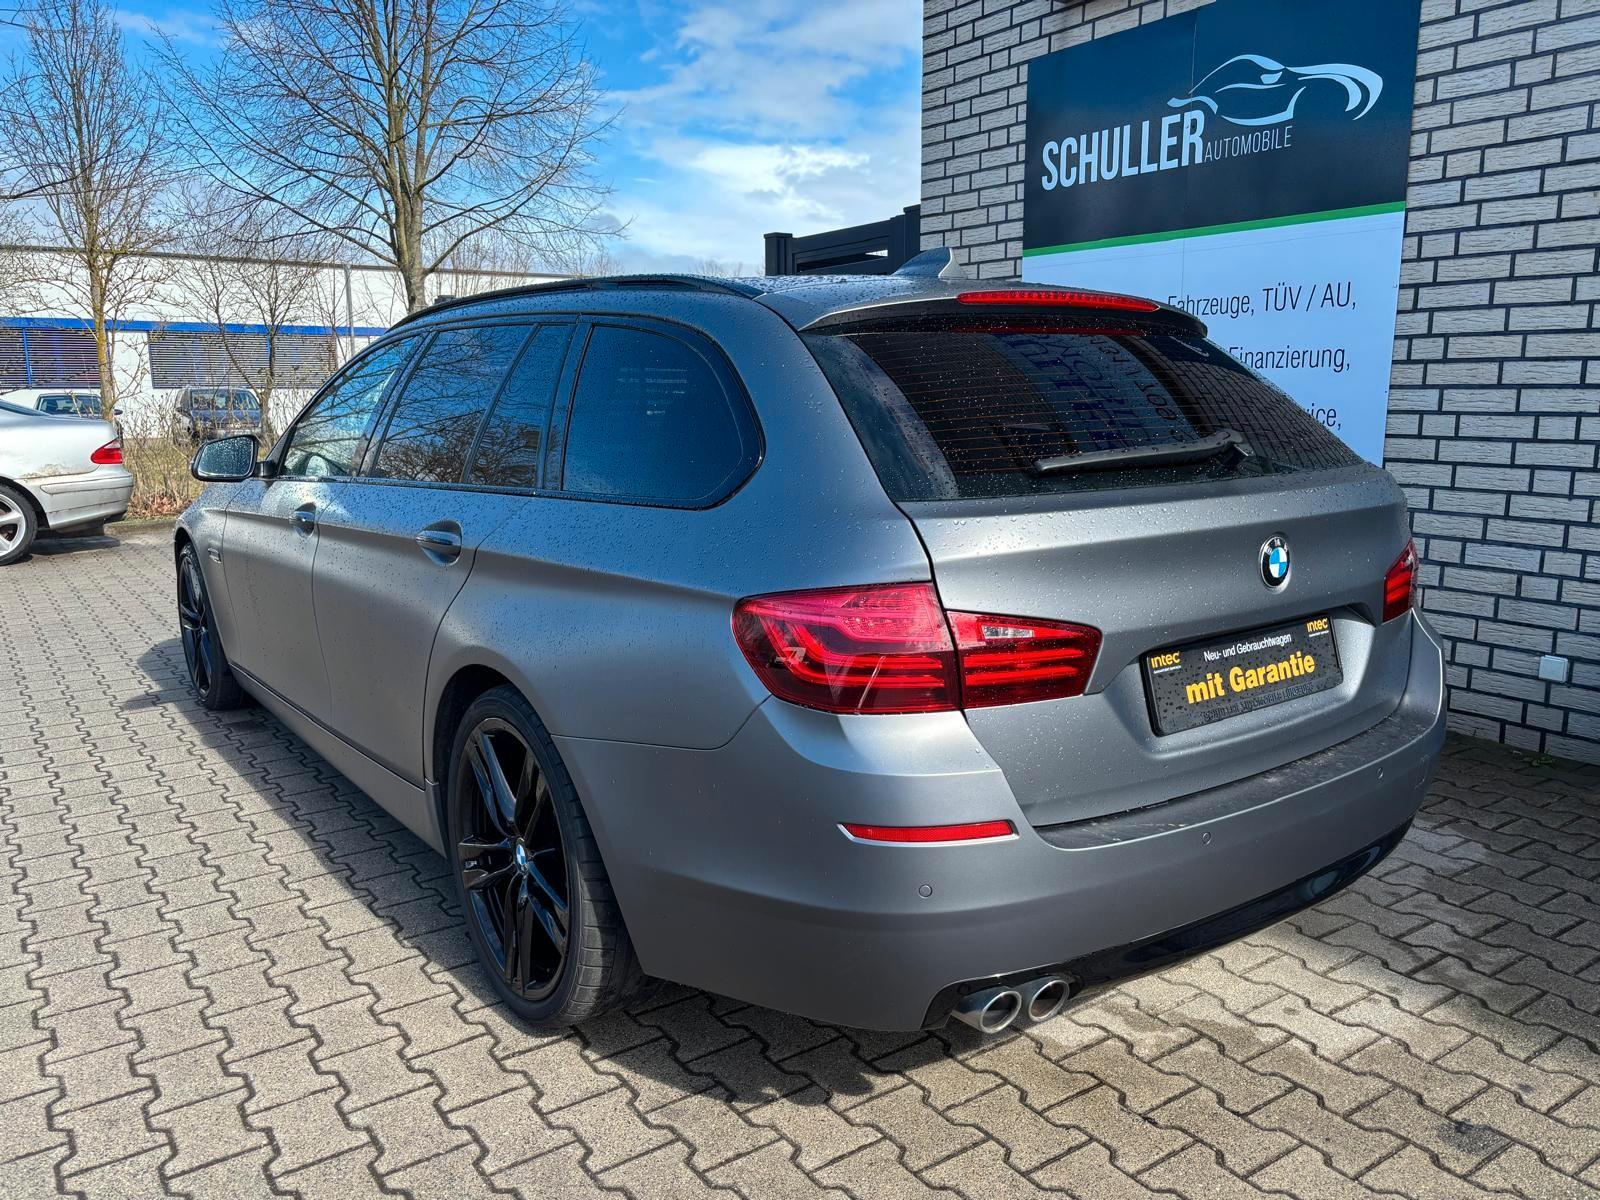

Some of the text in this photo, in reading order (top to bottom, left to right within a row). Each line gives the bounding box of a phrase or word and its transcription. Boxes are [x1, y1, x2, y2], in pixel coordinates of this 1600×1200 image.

[1041, 109, 1293, 191] SCHULLER AUTOMOBILE
[1262, 282, 1302, 312] TÜV
[1306, 284, 1317, 312] /
[1320, 281, 1356, 310] AU,
[1150, 650, 1181, 669] intec
[1203, 633, 1292, 662] Neu- und Gebrauchtwagen
[1185, 672, 1225, 704] mit
[1229, 651, 1316, 693] Garantie
